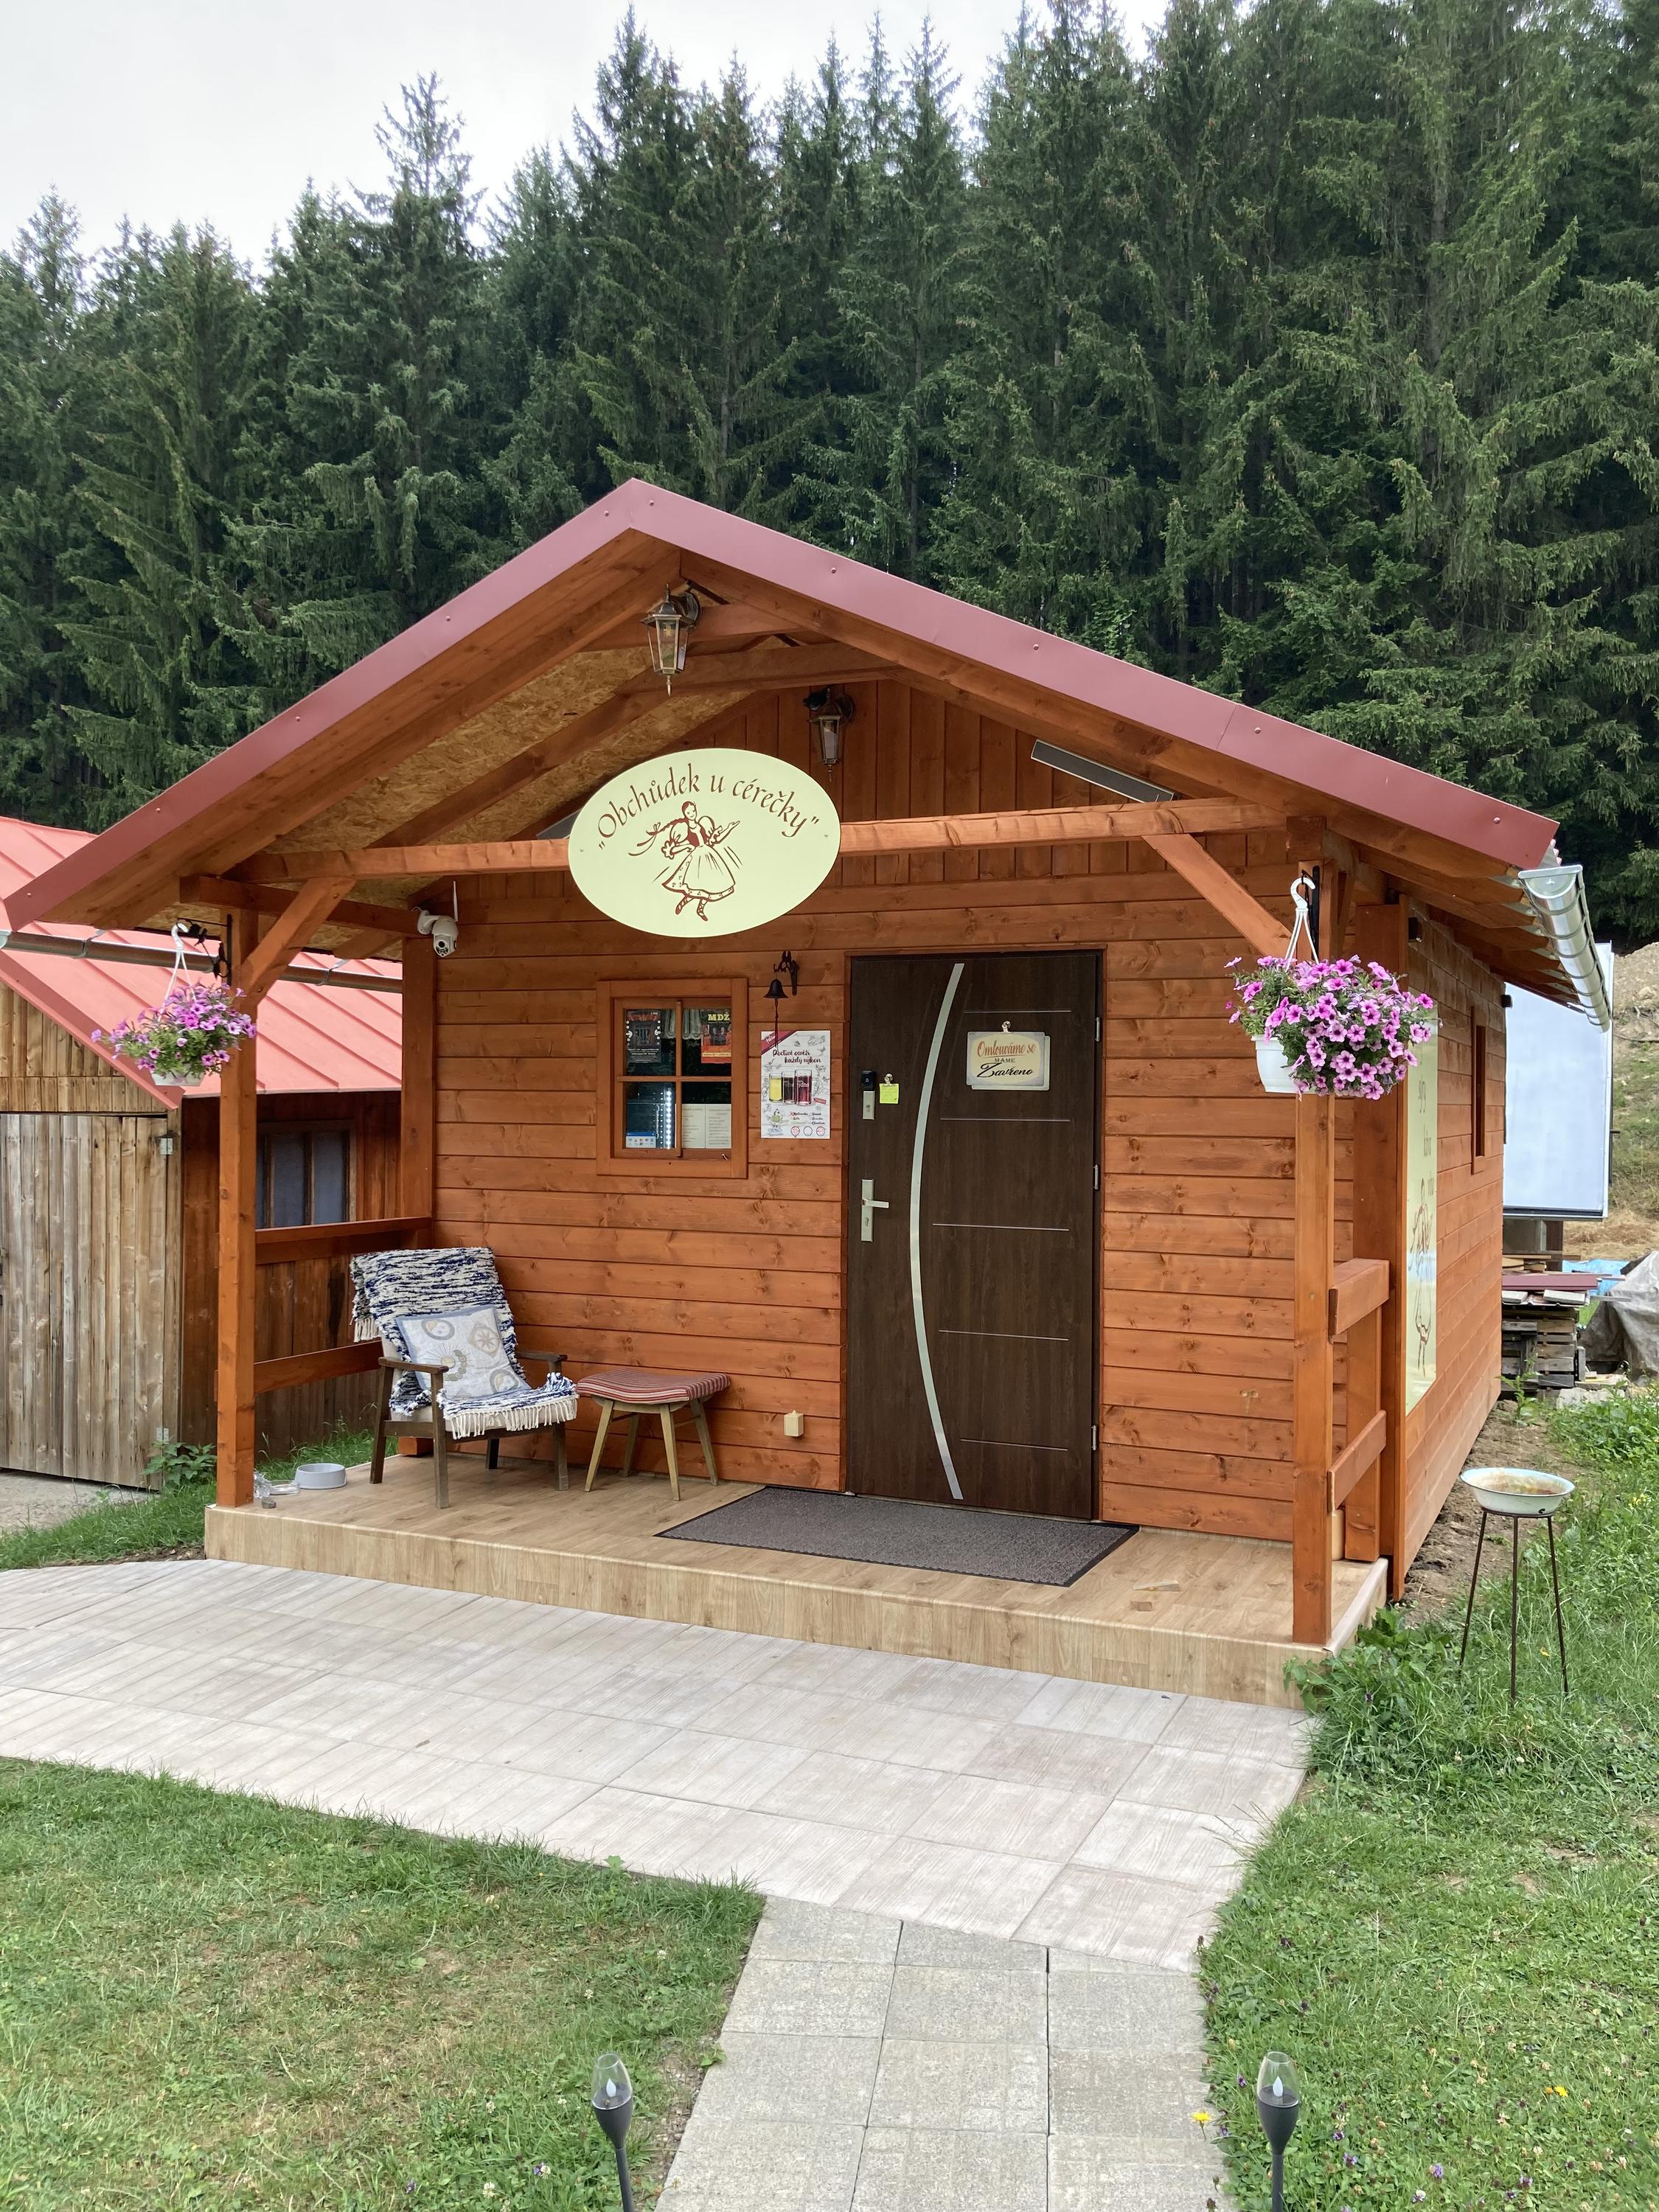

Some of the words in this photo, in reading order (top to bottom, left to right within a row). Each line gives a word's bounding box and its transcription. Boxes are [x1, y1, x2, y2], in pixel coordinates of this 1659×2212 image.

[711, 774, 725, 793] u
[708, 1012, 730, 1021] MDŽ
[1027, 1044, 1036, 1053] se
[976, 1062, 1033, 1077] Zavřeno
